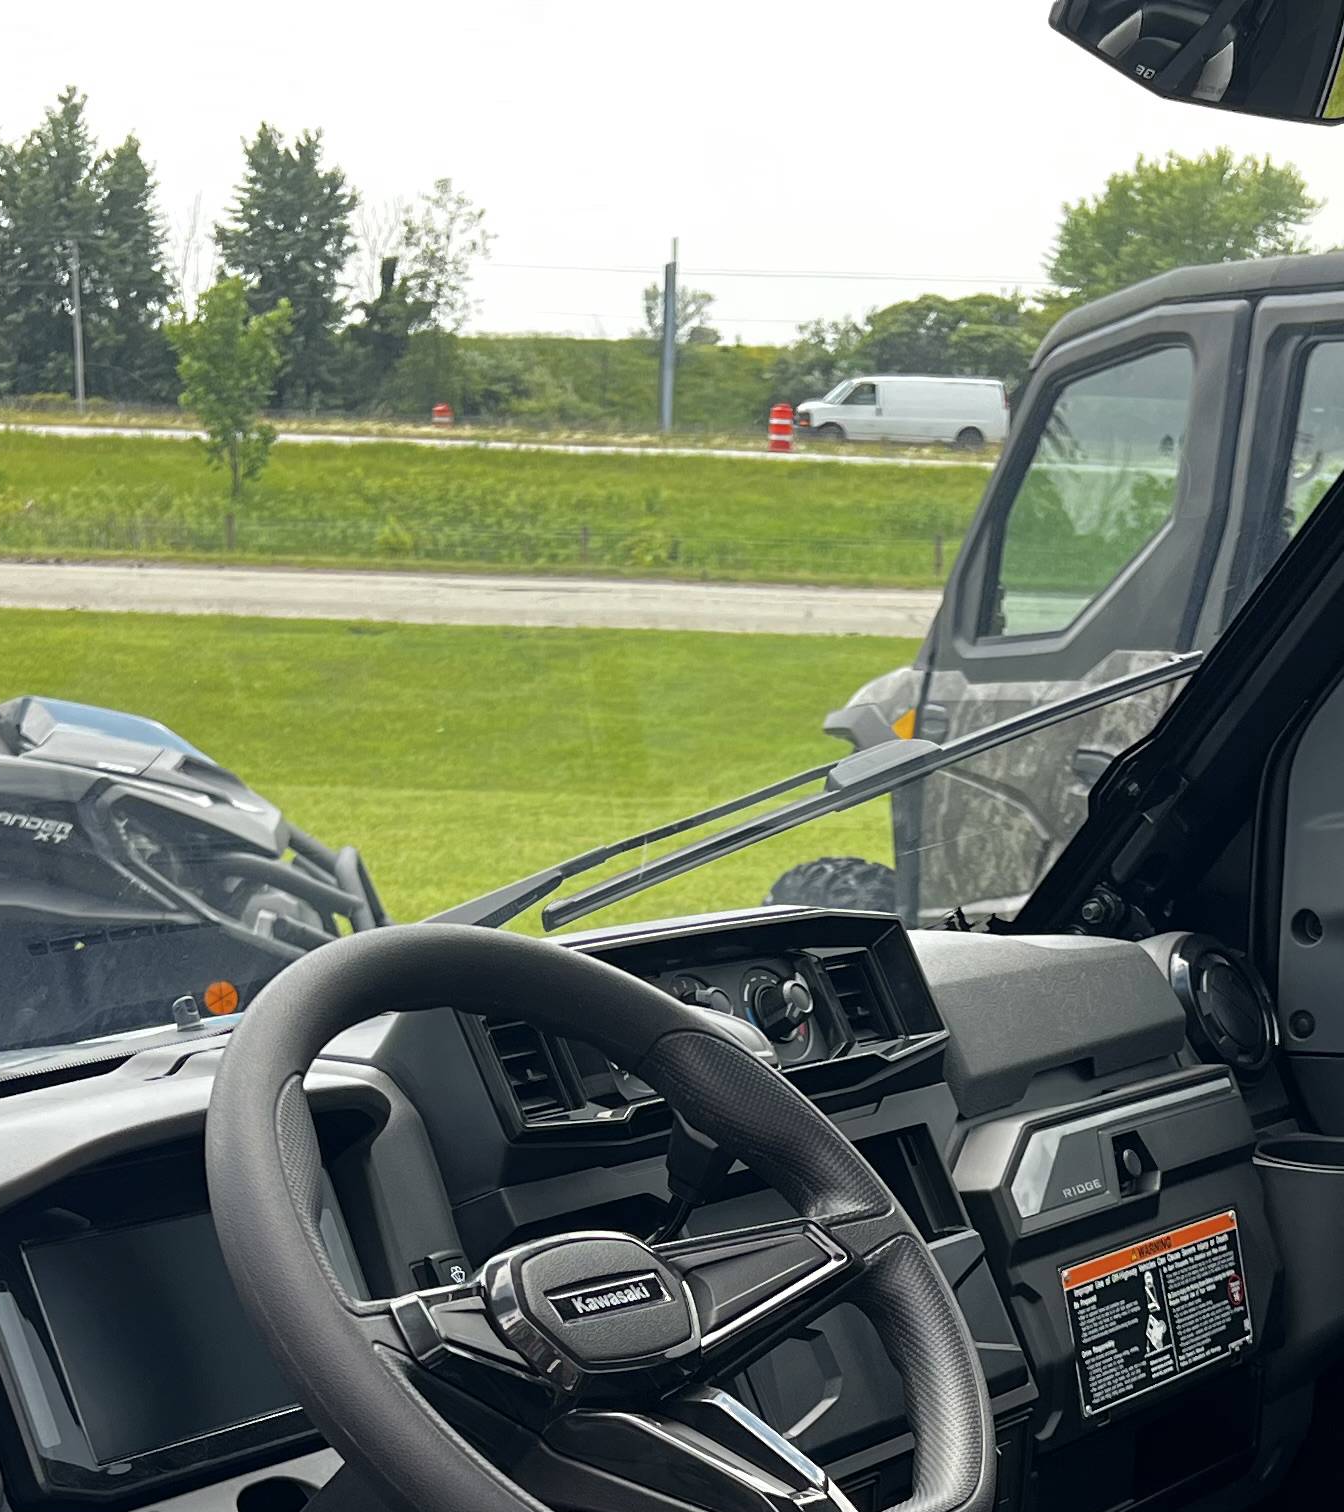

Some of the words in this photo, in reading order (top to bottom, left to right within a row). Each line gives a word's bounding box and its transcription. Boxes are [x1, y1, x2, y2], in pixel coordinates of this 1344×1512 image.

[33, 830, 70, 844] XT
[1062, 1178, 1102, 1198] RIDGE
[1138, 1236, 1171, 1257] WARNING
[571, 1282, 651, 1314] Kawasaki
